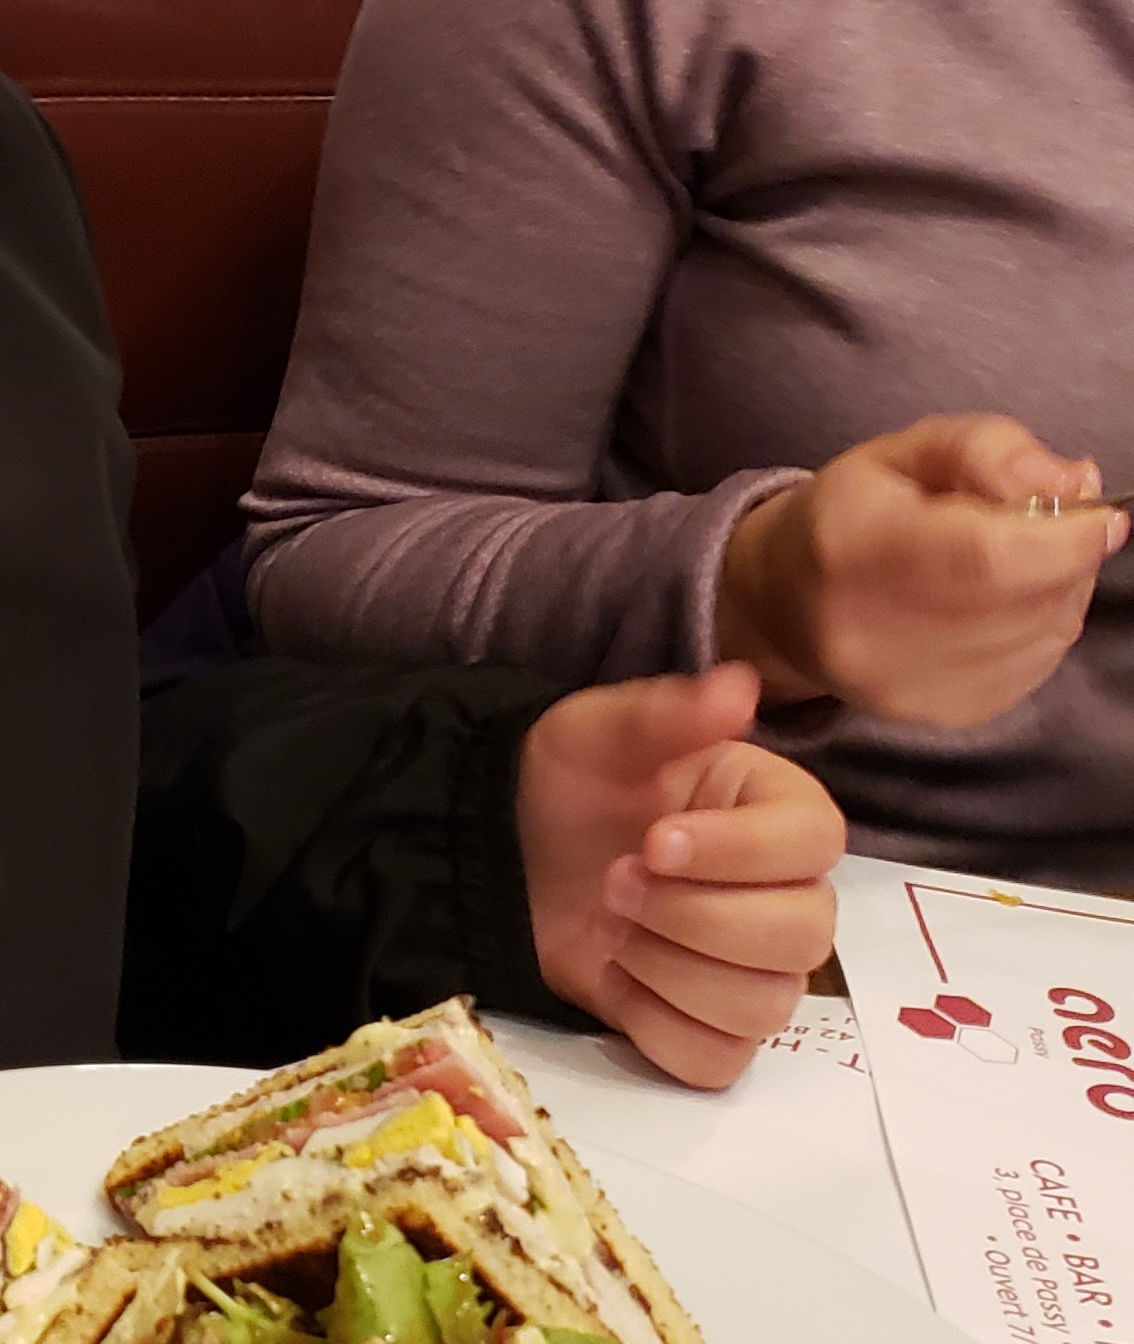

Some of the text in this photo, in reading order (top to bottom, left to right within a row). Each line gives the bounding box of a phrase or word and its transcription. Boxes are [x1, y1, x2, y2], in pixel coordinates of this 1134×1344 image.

[996, 1187, 1037, 1242] place
[1030, 1159, 1083, 1223] CAFE
[1062, 1253, 1113, 1306] BAR
[984, 1249, 1029, 1319] Ouvert
[1021, 1246, 1049, 1272] de
[1031, 1277, 1070, 1334] Passy
